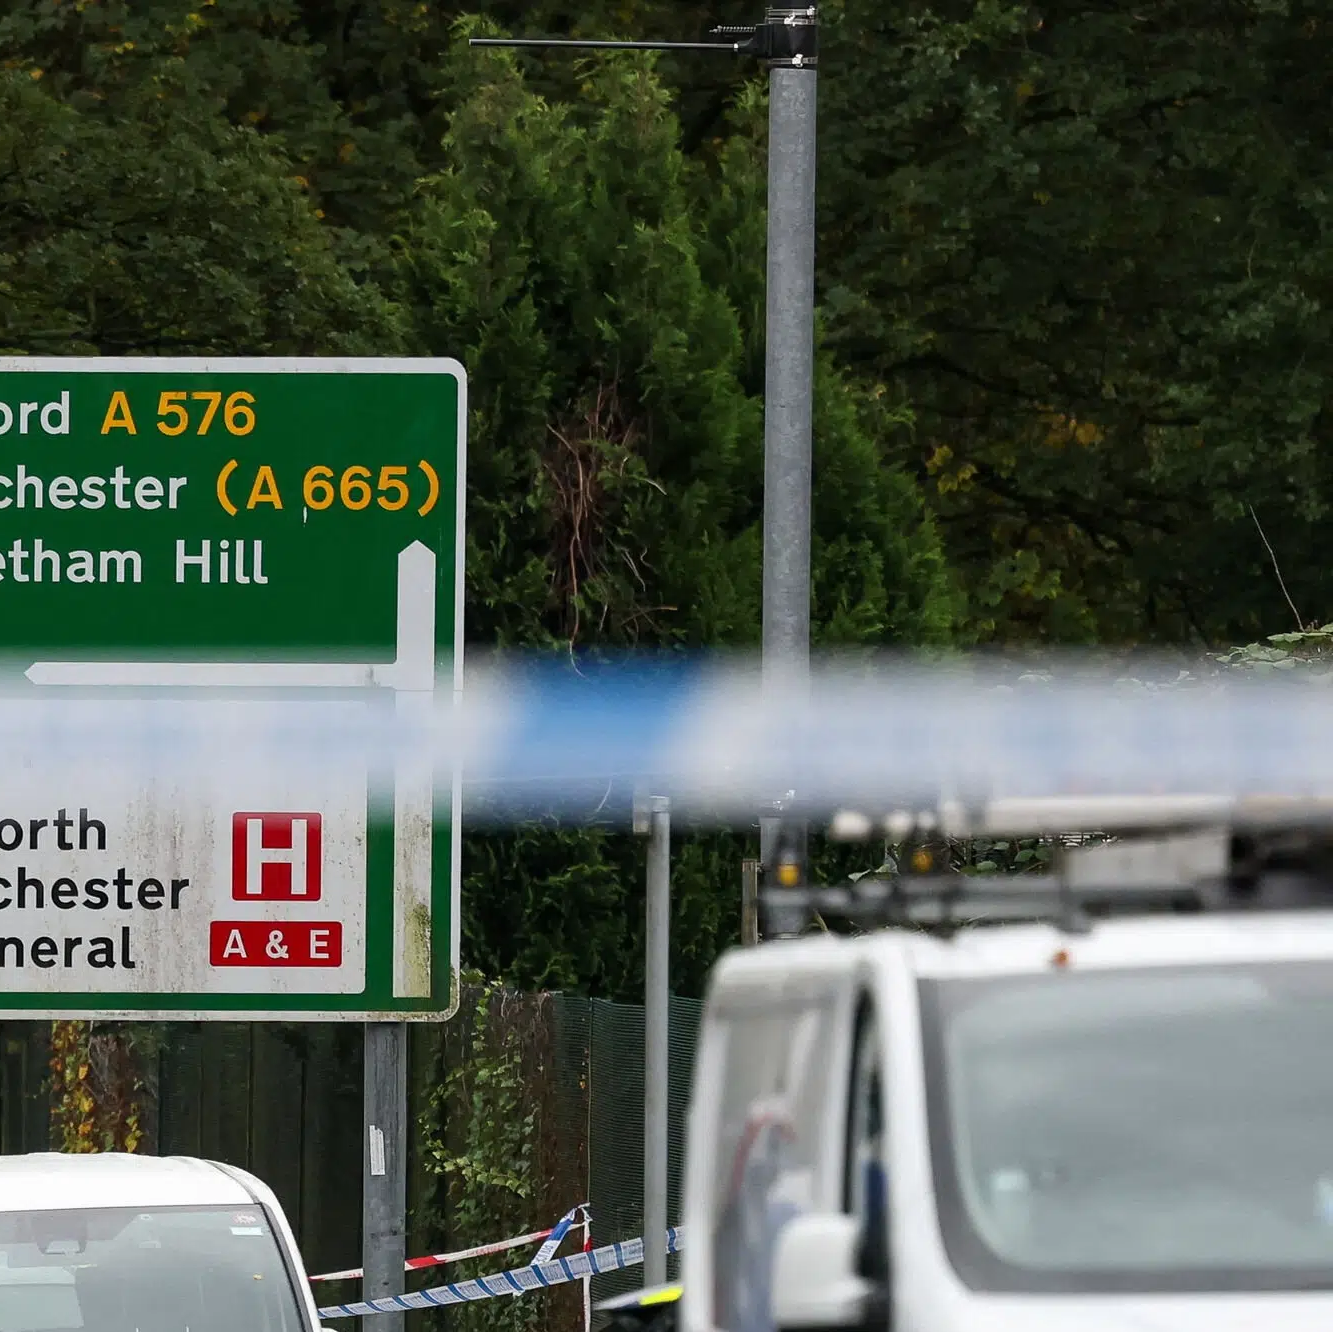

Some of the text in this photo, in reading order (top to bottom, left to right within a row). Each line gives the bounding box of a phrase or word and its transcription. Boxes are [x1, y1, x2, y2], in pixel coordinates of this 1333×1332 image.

[100, 391, 137, 435] A
[156, 391, 256, 436] 576
[216, 459, 283, 516] (A
[302, 460, 439, 517] 665)
[175, 539, 269, 585] Hill
[222, 928, 331, 960] A & E
